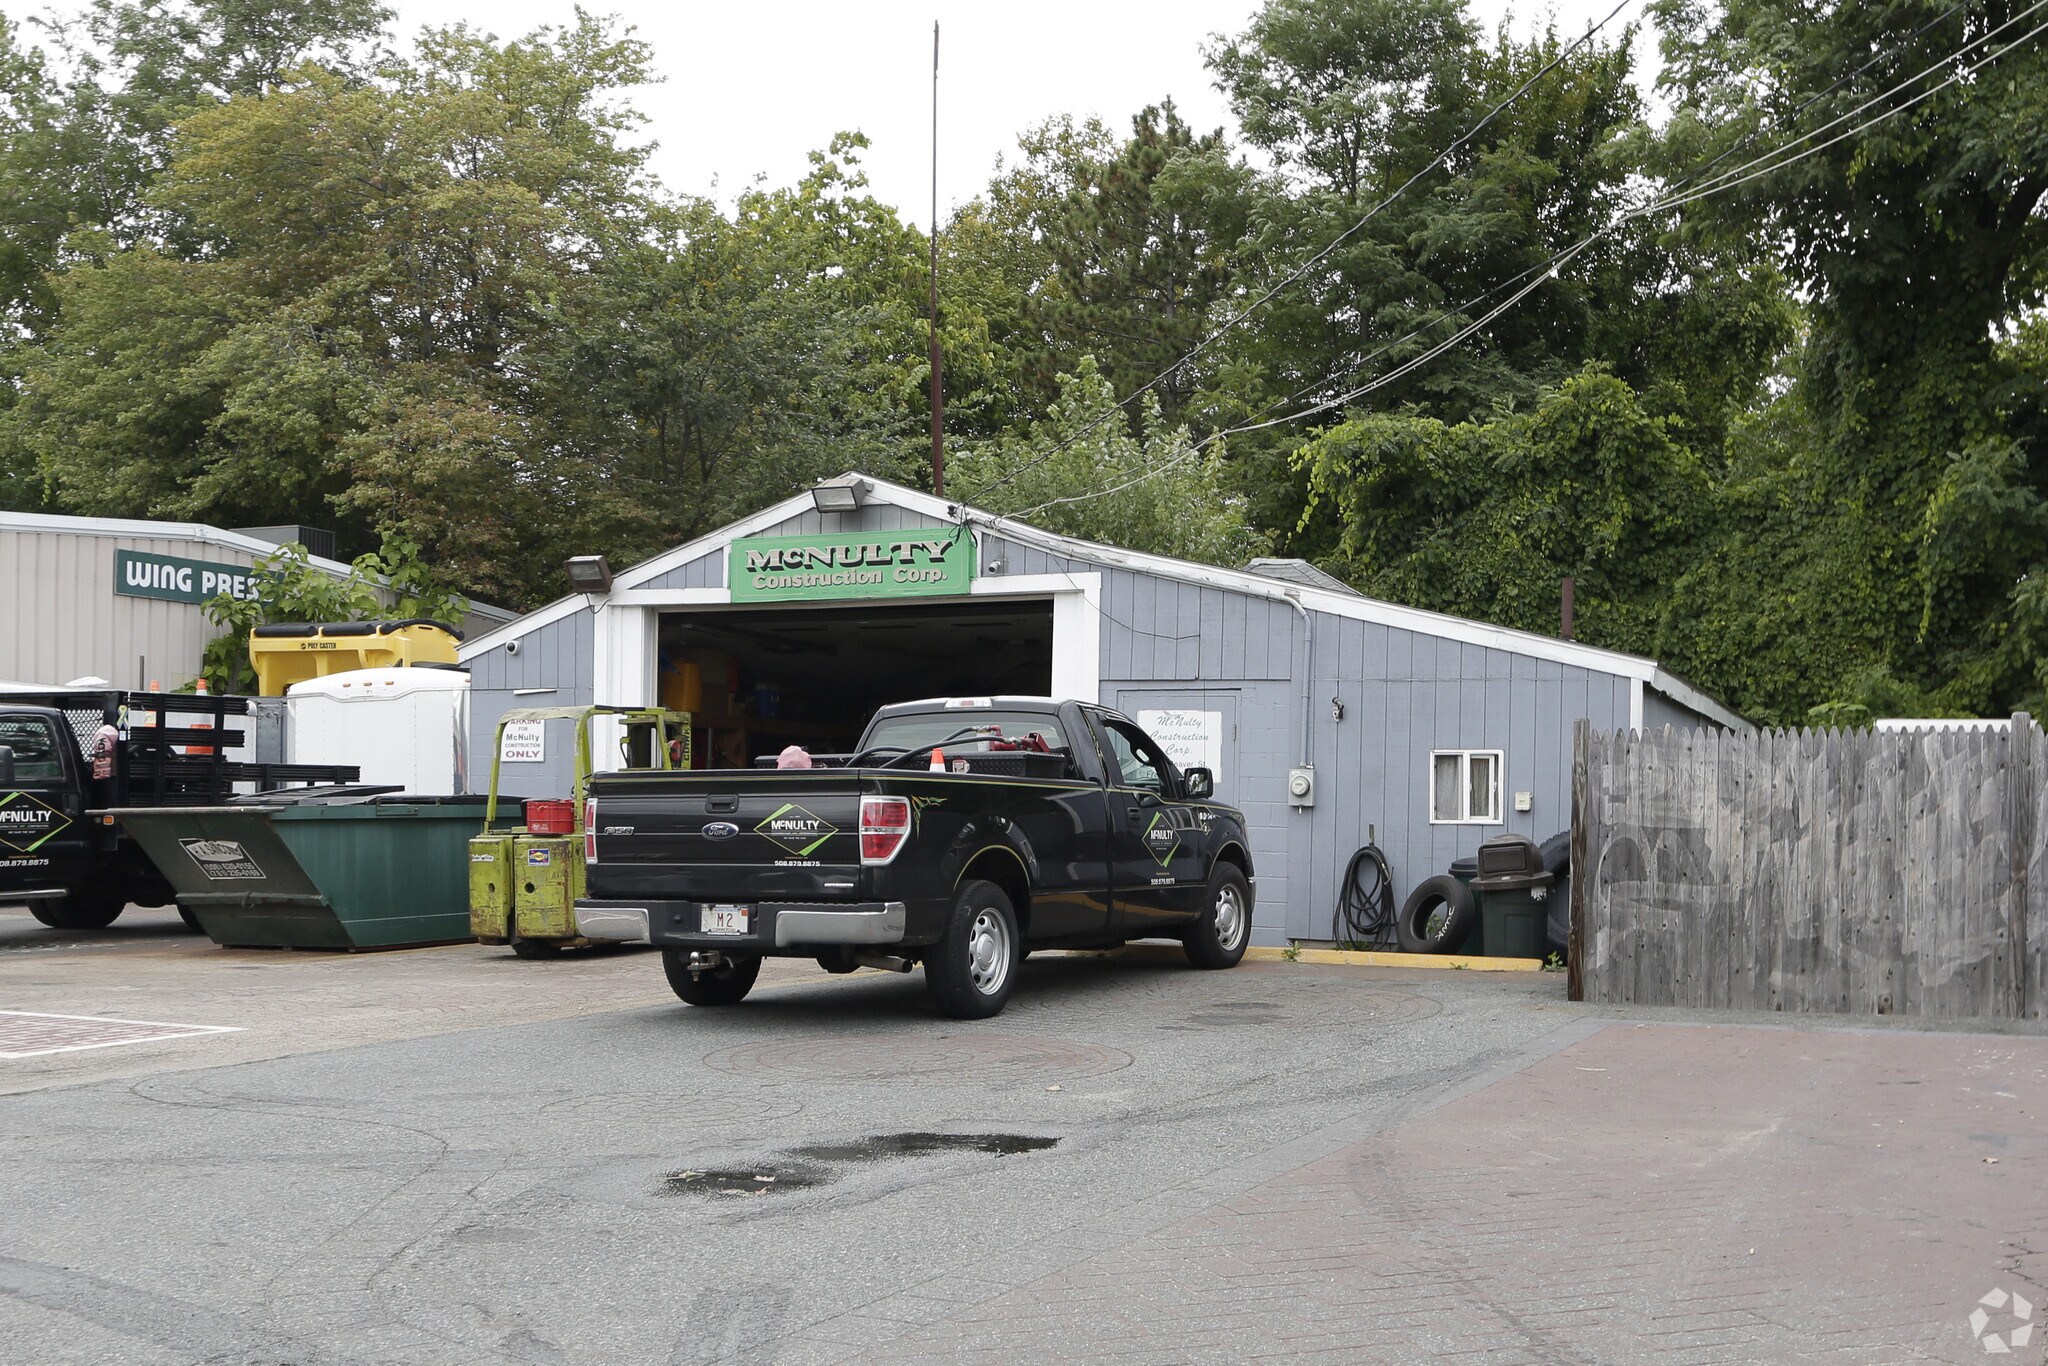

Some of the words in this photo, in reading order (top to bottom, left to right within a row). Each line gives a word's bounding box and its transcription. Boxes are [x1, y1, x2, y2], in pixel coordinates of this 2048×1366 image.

[126, 560, 192, 593] WING
[202, 570, 275, 603] PRES
[752, 569, 884, 590] Construction
[892, 566, 949, 584] Corp.
[1157, 715, 1202, 729] McNulty
[506, 734, 540, 742] McNulty
[1150, 730, 1209, 741] Construction
[1165, 743, 1192, 756] Corp.
[708, 825, 729, 836] Ford
[0, 858, 49, 867] 08.879.8875
